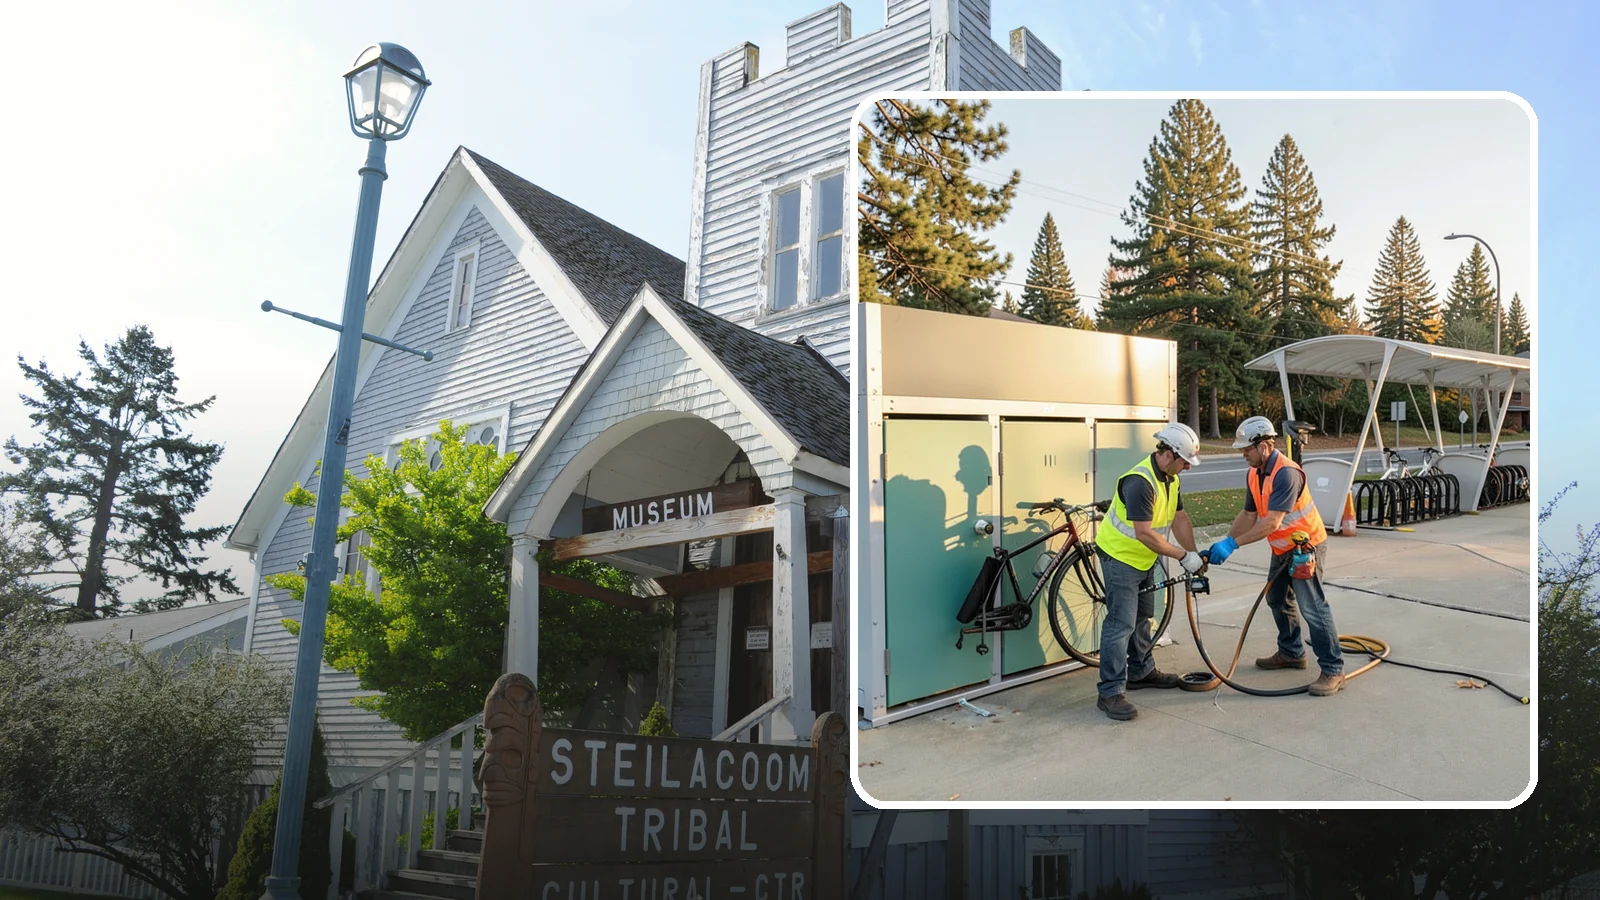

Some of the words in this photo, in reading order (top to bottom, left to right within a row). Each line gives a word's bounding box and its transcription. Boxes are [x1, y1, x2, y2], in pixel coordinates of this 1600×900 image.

[613, 491, 714, 530] MUSEUM
[551, 738, 809, 792] STEILACOOM
[615, 806, 757, 851] TRIBAL
